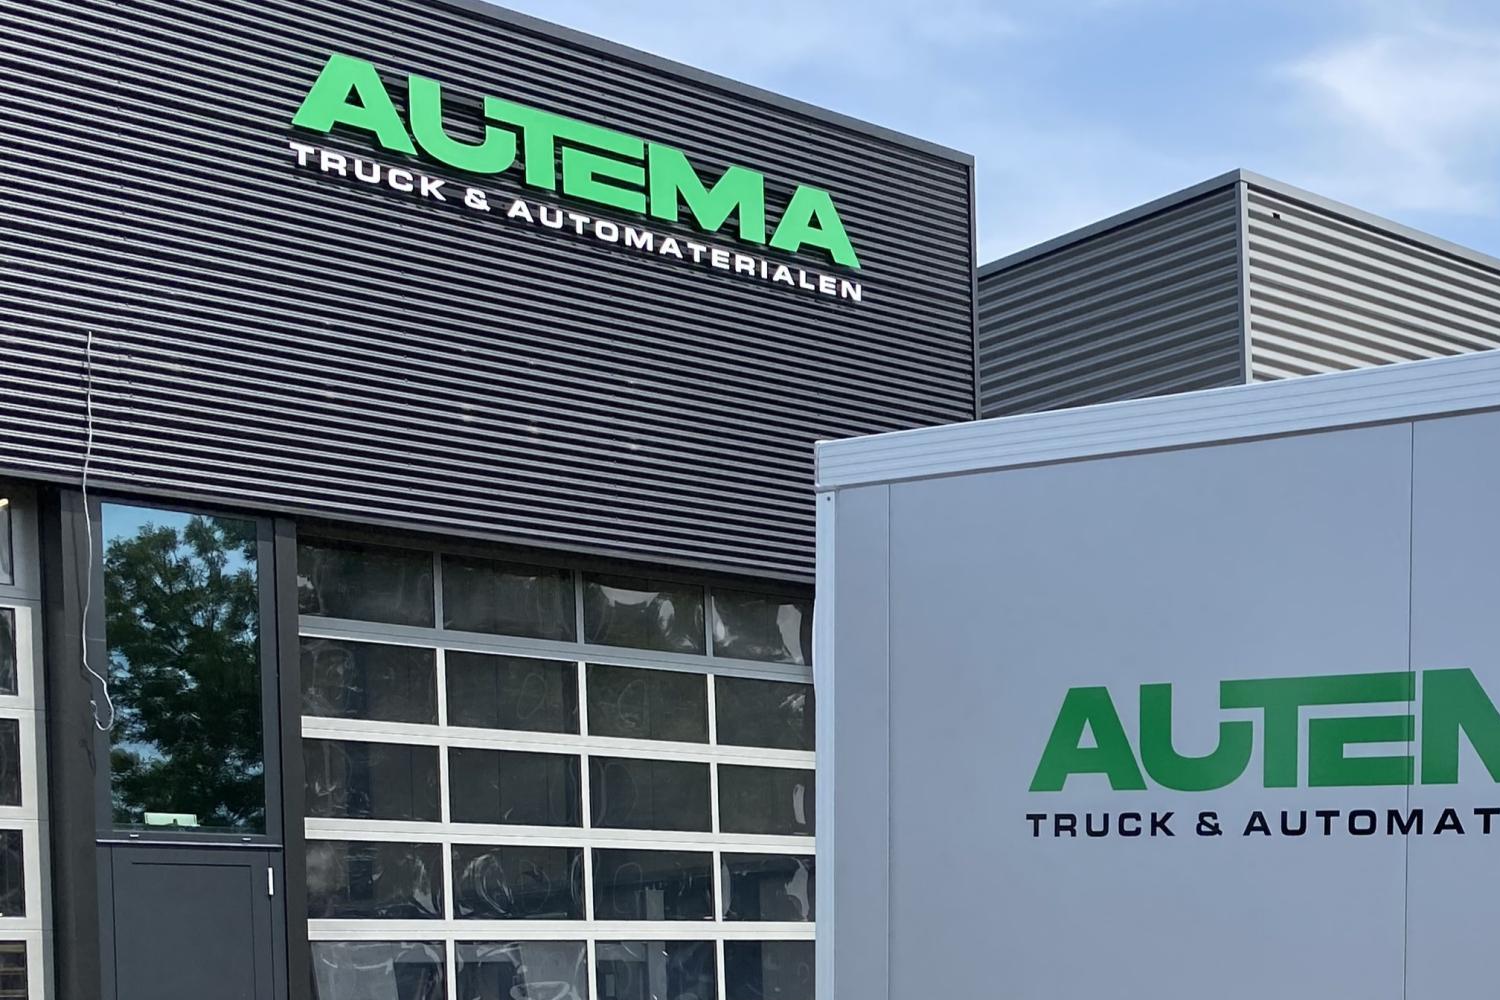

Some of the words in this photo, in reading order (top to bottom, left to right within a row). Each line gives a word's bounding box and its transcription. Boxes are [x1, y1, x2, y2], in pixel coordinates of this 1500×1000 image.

[289, 141, 446, 201] TRUCK
[464, 186, 491, 212] &
[507, 198, 862, 302] AUTOMATERIALEN
[291, 53, 861, 269] AUTEMA
[1026, 812, 1175, 838] TRUCK
[1195, 811, 1224, 837] &
